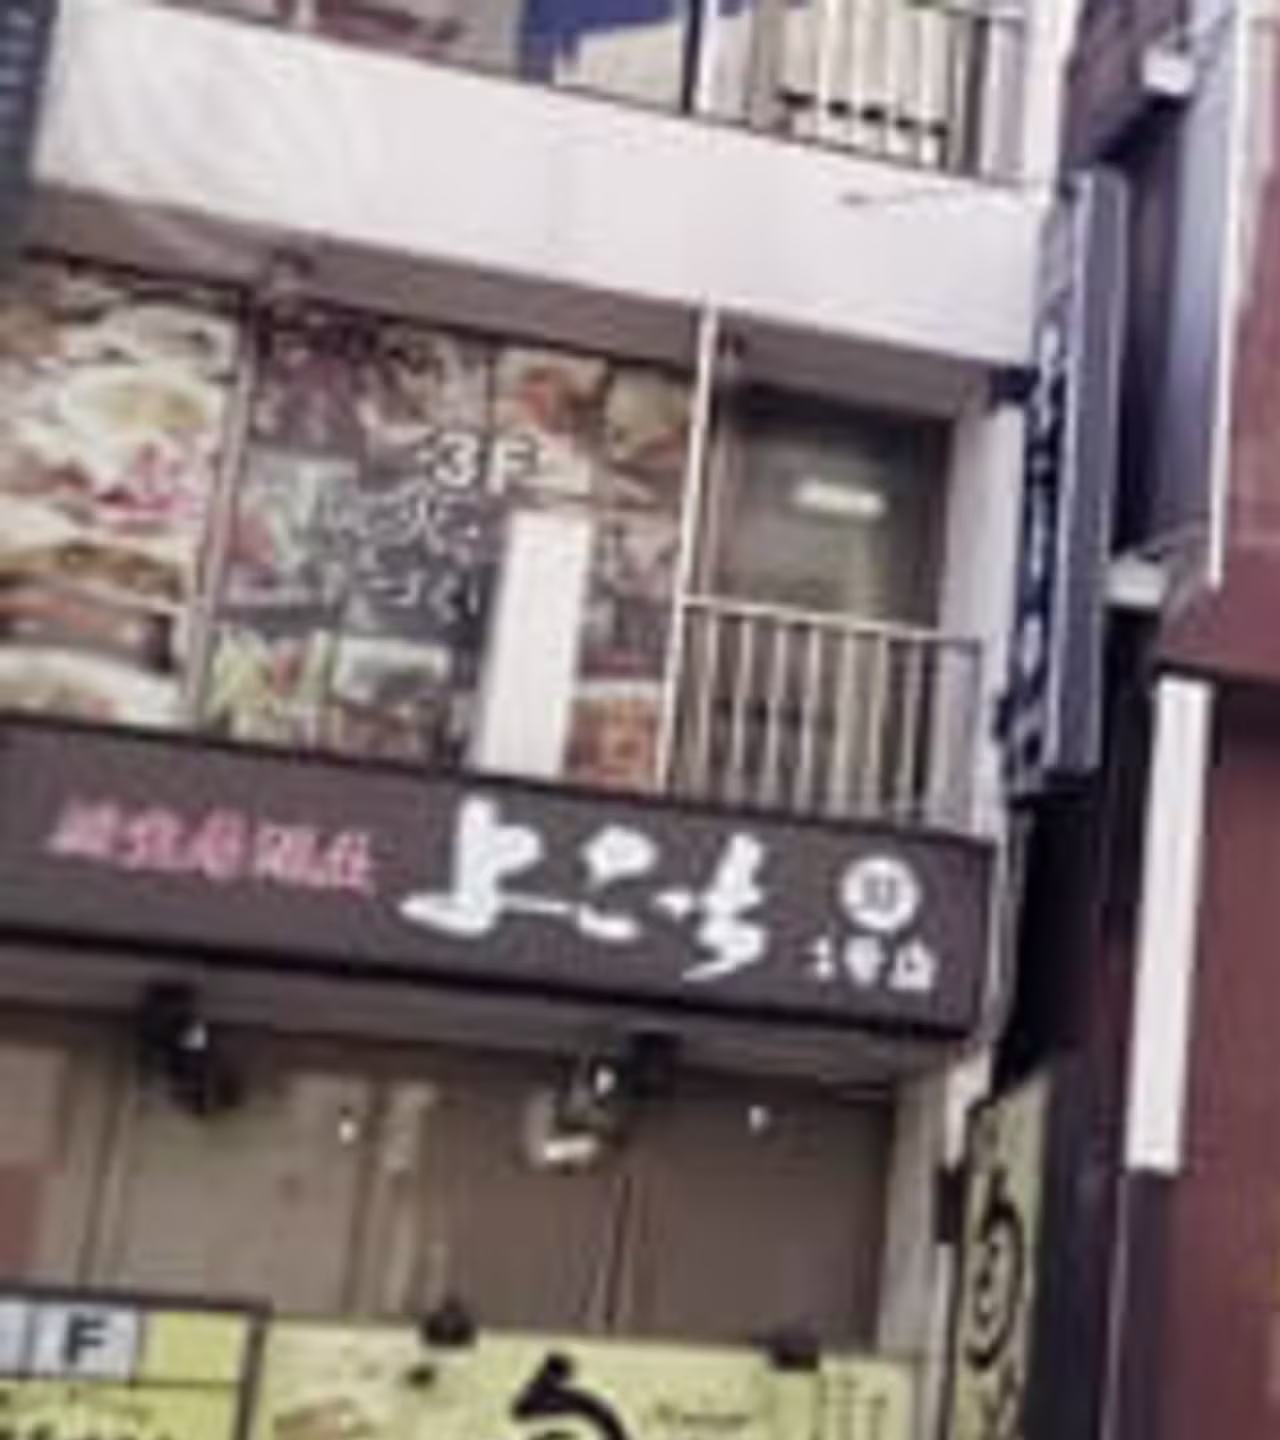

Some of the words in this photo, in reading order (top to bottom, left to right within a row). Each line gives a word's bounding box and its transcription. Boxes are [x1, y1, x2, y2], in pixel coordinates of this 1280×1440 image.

[400, 796, 772, 983] よこち
[60, 1312, 108, 1365] F
